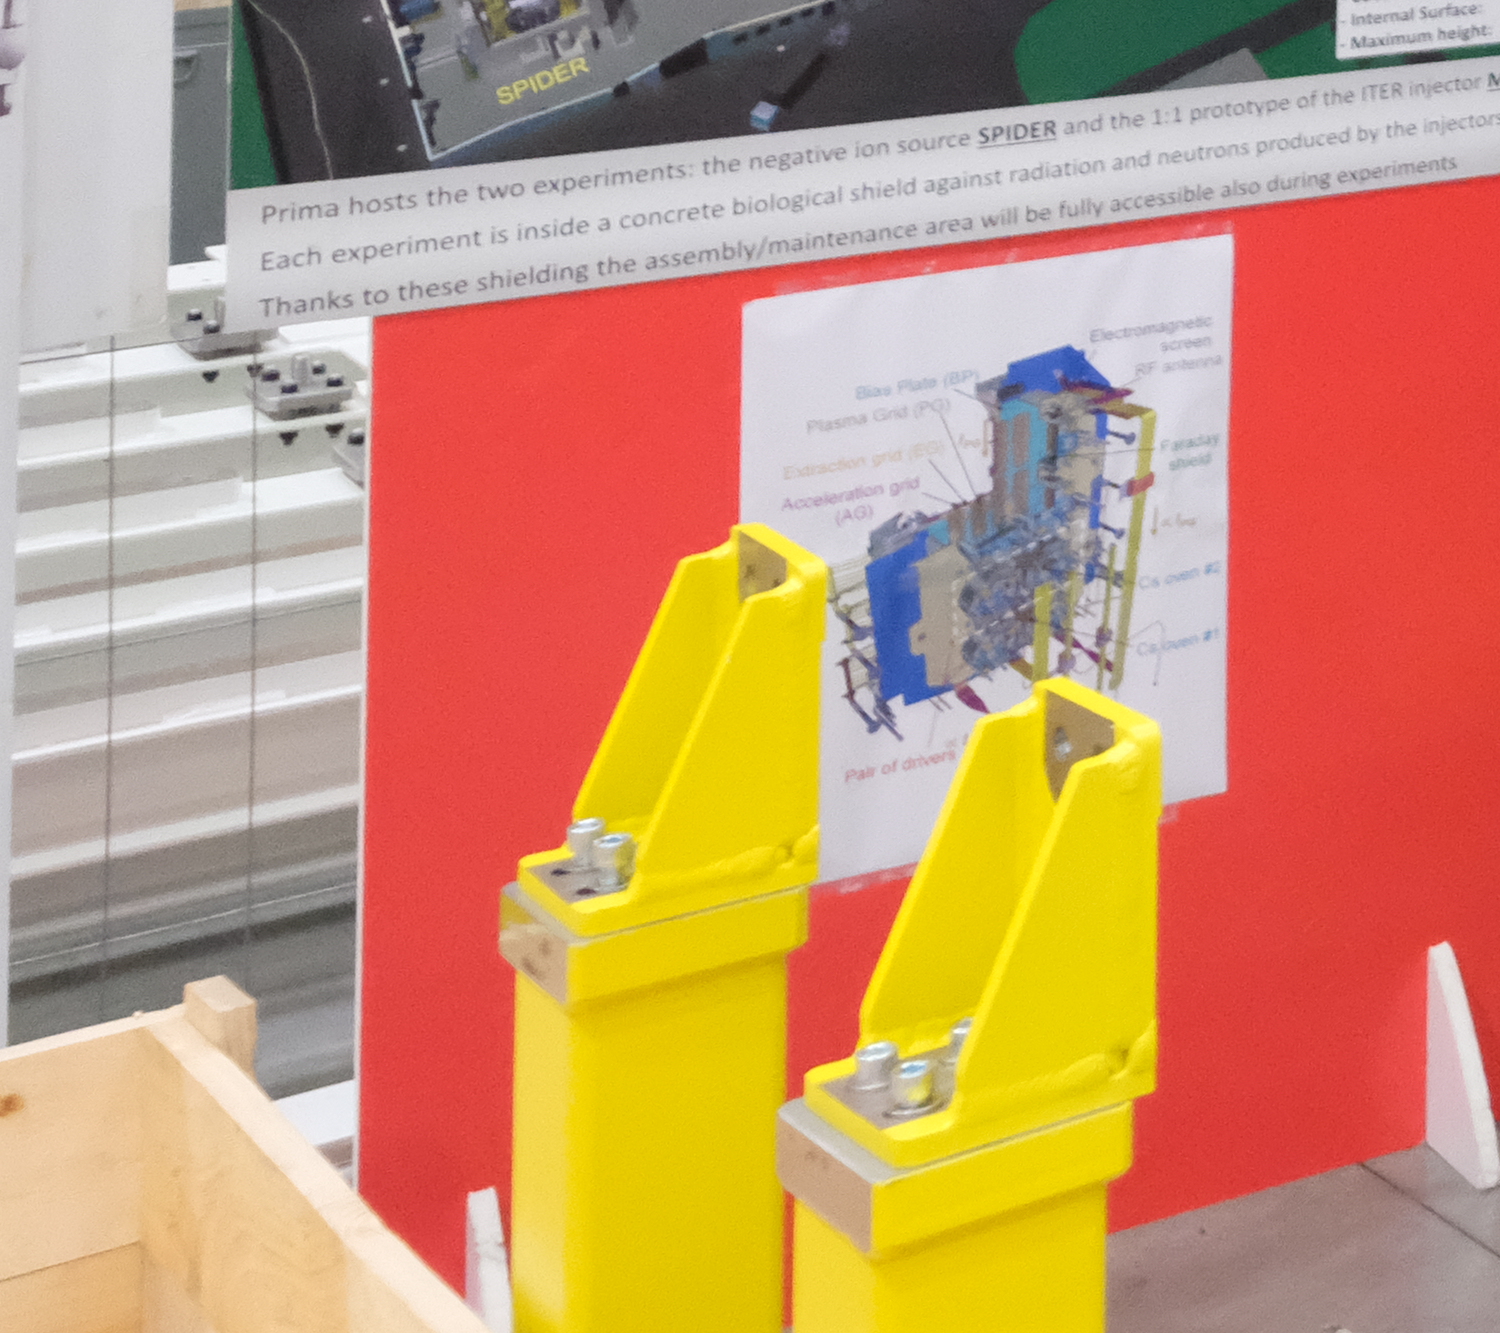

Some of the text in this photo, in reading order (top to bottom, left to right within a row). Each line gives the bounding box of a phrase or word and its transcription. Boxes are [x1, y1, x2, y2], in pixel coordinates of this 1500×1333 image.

[1351, 8, 1414, 27] Internal
[1419, 2, 1483, 20] Surface:
[1350, 31, 1433, 50] Maximum
[1437, 25, 1493, 44] height:
[495, 57, 590, 106] SPIDER
[261, 204, 339, 226] Prima
[348, 192, 418, 217] hosts
[427, 185, 468, 208] the
[476, 182, 525, 201] two
[533, 160, 694, 198] experiments:
[702, 154, 742, 176] the
[749, 144, 848, 176] negative
[854, 140, 891, 159] ion
[897, 132, 971, 155] source
[977, 119, 1056, 149] SPIDER
[1064, 113, 1103, 135] and
[1111, 109, 1144, 130] the
[1153, 105, 1182, 126] 1:1
[1190, 96, 1290, 126] prototype
[1297, 87, 1317, 108] of
[1324, 85, 1354, 106] the
[1361, 82, 1403, 102] ITER
[1409, 74, 1482, 101] injector
[260, 248, 322, 272] Each
[331, 229, 482, 265] experiment
[491, 225, 509, 244] is
[516, 215, 589, 242] inside
[597, 217, 611, 232] a
[619, 202, 725, 230] concrete
[732, 185, 843, 217] biological
[849, 177, 917, 203] shield
[923, 168, 1002, 196] against
[1008, 155, 1105, 184] radiation
[1112, 149, 1151, 171] and
[1157, 140, 1250, 166] neutrons
[1255, 127, 1350, 158] produced
[1356, 123, 1380, 144] by
[1386, 118, 1417, 138] the
[258, 154, 1458, 319] Thanks to these shielding the assembly/maintenance area will be fully accessible also during experiments
[1089, 314, 1213, 344] Electromagnetic
[1160, 336, 1212, 353] screen
[1162, 354, 1223, 373] antenna
[855, 384, 893, 401] Bias
[896, 377, 938, 394] Plate
[806, 413, 868, 435] Plasma
[871, 405, 909, 423] Grid
[1159, 433, 1221, 453] Faraday
[783, 455, 868, 481] Extraction
[871, 449, 904, 468] grid
[781, 475, 921, 512] Acceleration grid
[835, 503, 875, 528] (AG)
[844, 748, 957, 783] Pair of drivers
